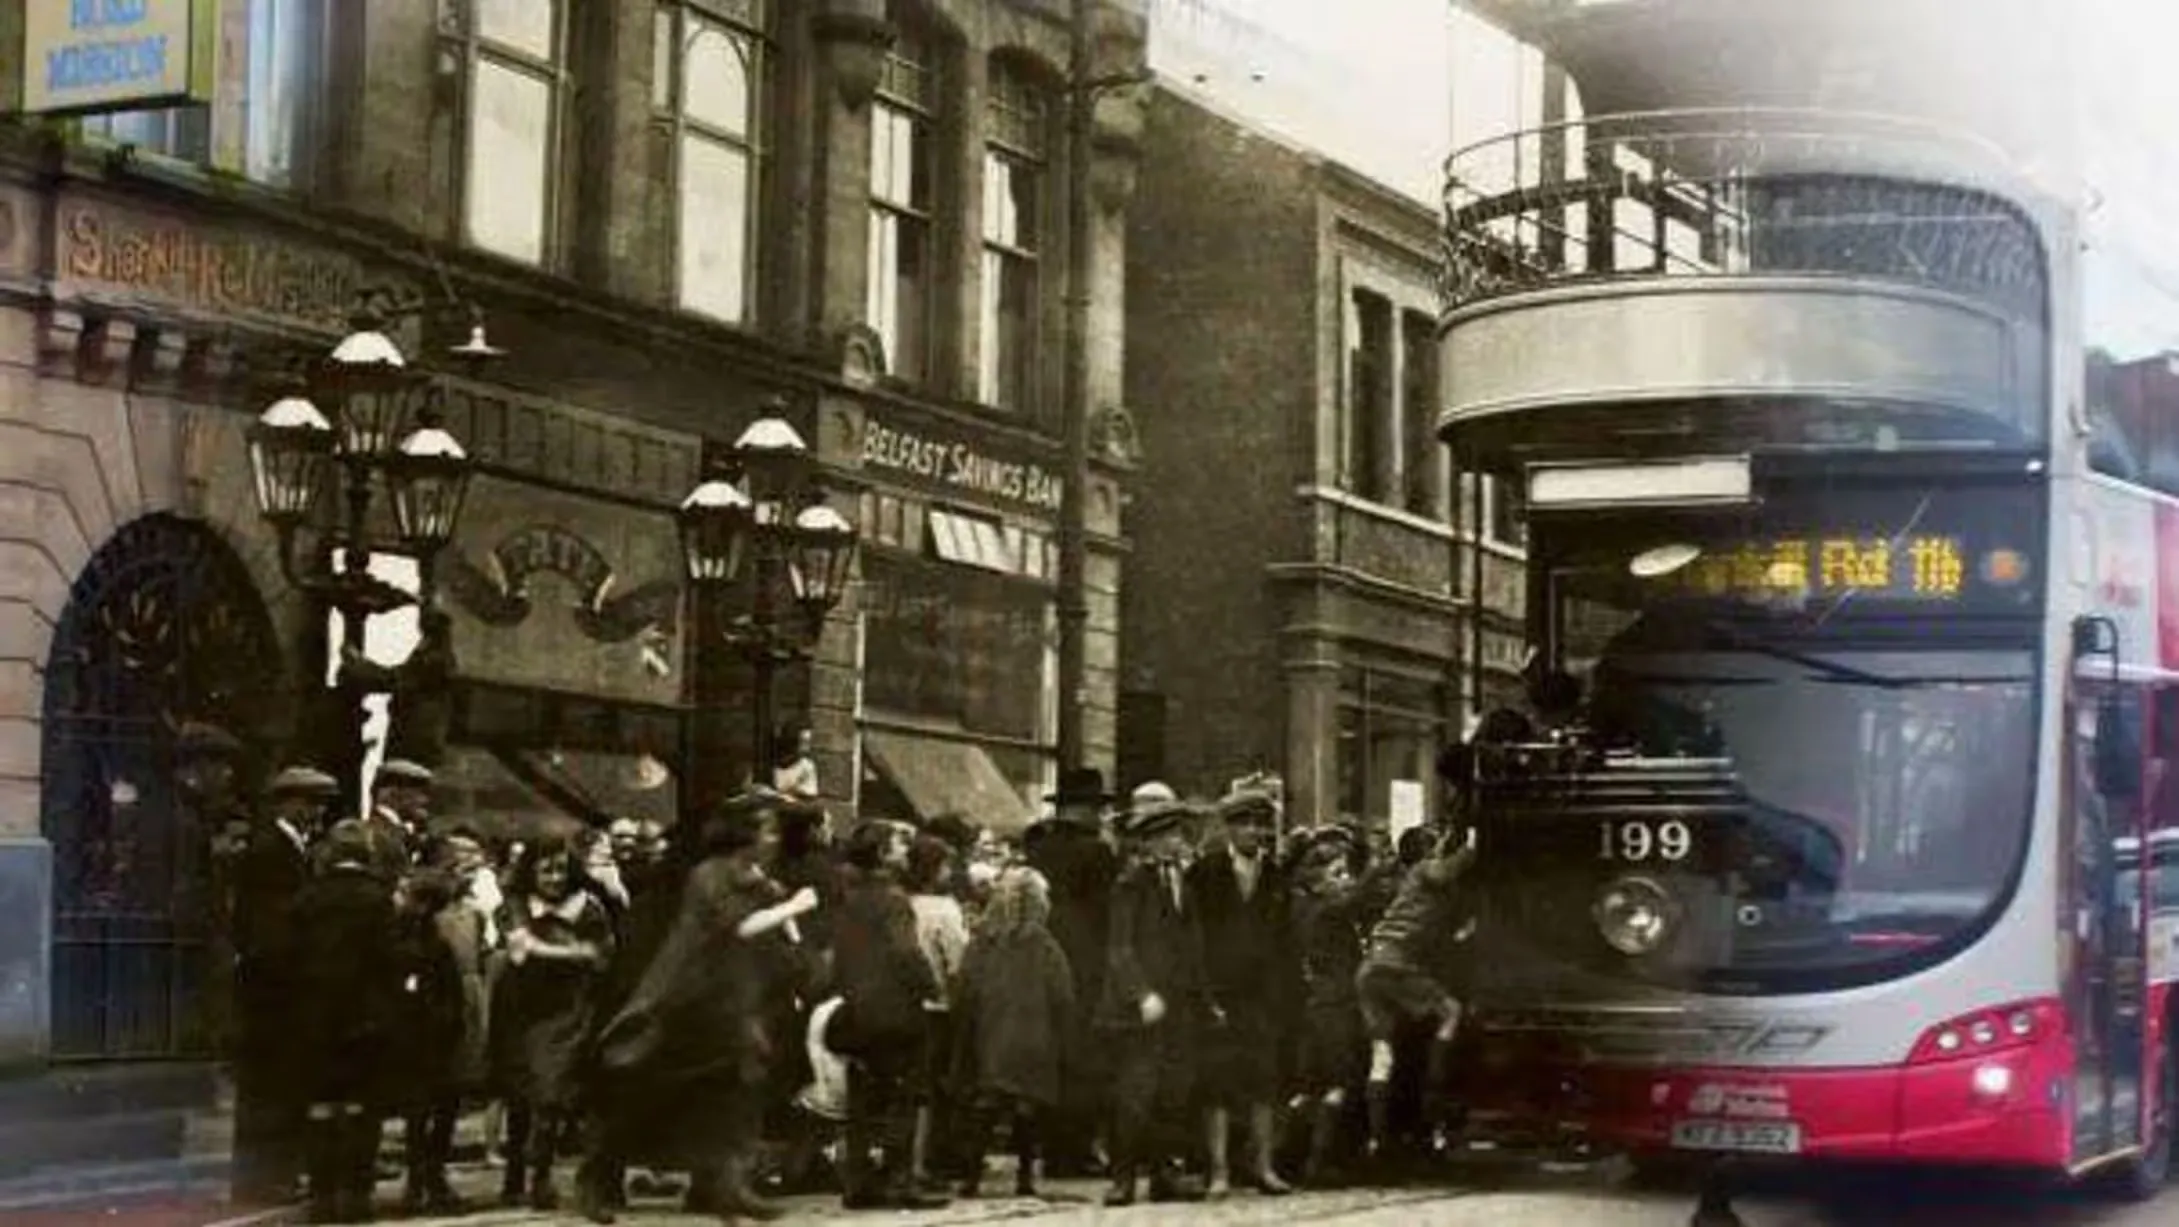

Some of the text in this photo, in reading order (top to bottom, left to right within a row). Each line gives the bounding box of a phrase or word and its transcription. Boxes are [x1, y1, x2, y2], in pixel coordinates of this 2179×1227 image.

[863, 420, 1065, 512] BELFAST SAVINGS BAN
[1821, 538, 1889, 587] Rd
[1597, 820, 1691, 861] 199
